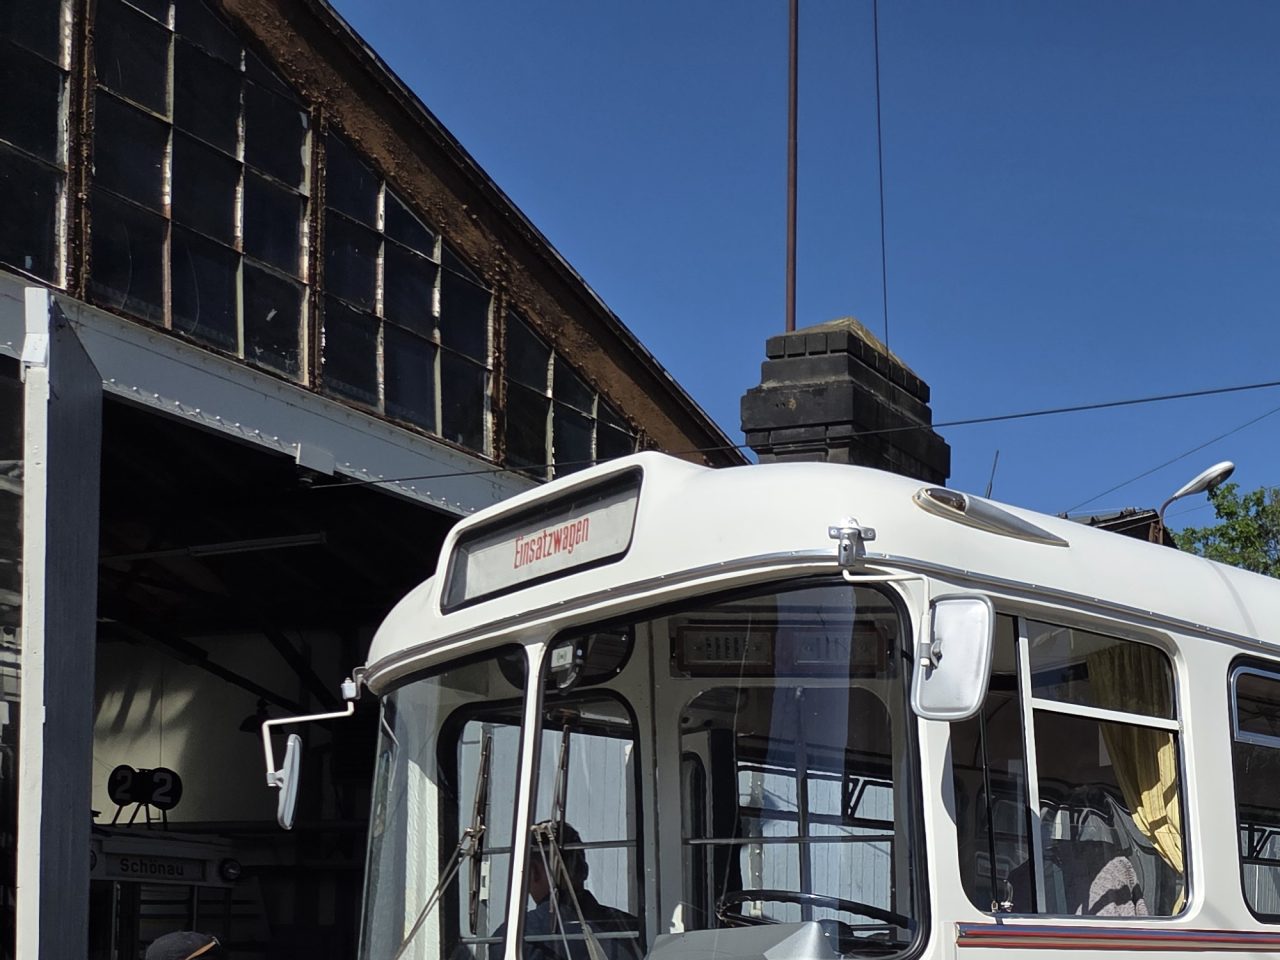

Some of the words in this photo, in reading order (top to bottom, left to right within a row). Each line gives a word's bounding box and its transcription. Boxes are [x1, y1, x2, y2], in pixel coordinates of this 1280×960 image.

[514, 517, 589, 569] Einsatzwagen
[115, 769, 133, 800] 2
[152, 772, 173, 803] 2
[119, 858, 184, 876] Schönau
